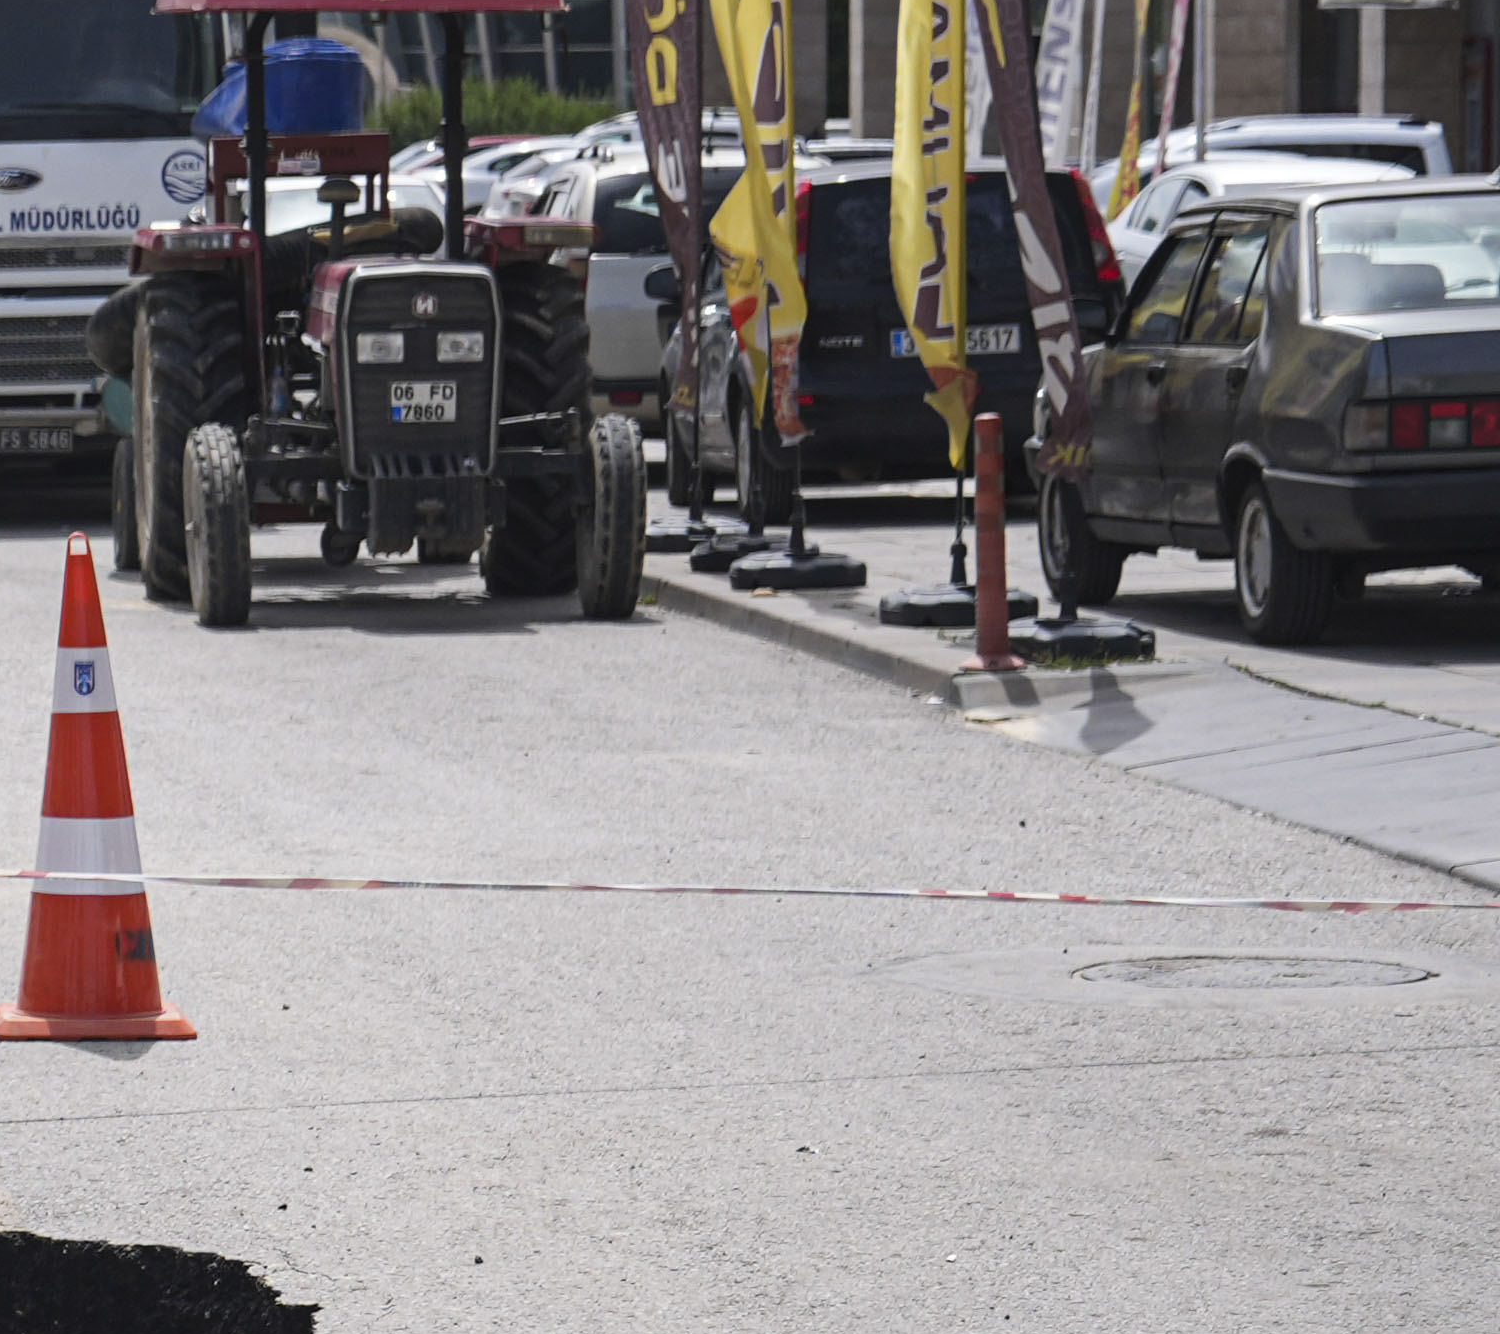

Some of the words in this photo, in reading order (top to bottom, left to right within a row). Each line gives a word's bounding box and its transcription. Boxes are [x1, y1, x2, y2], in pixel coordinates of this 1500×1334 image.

[10, 201, 141, 233] MÜDÜRLÜĞÜ
[393, 383, 415, 401] 06
[429, 384, 454, 401] FD
